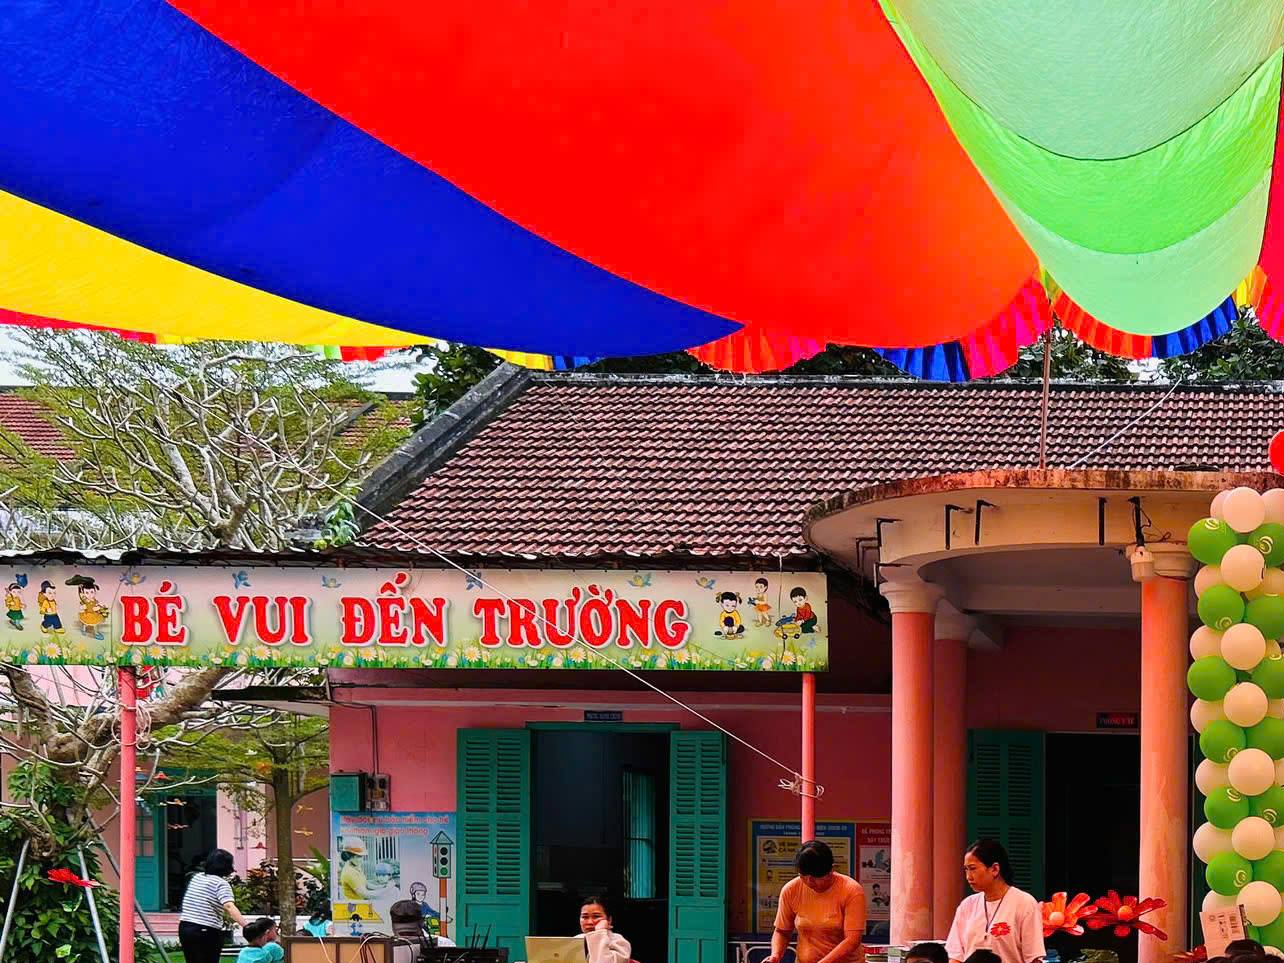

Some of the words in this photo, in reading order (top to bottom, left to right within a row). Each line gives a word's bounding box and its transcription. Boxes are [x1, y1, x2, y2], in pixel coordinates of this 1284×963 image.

[120, 581, 187, 645] BÉ
[212, 595, 314, 645] VUI
[342, 573, 448, 645] ĐẾN
[474, 584, 691, 648] TRƯỜNG
